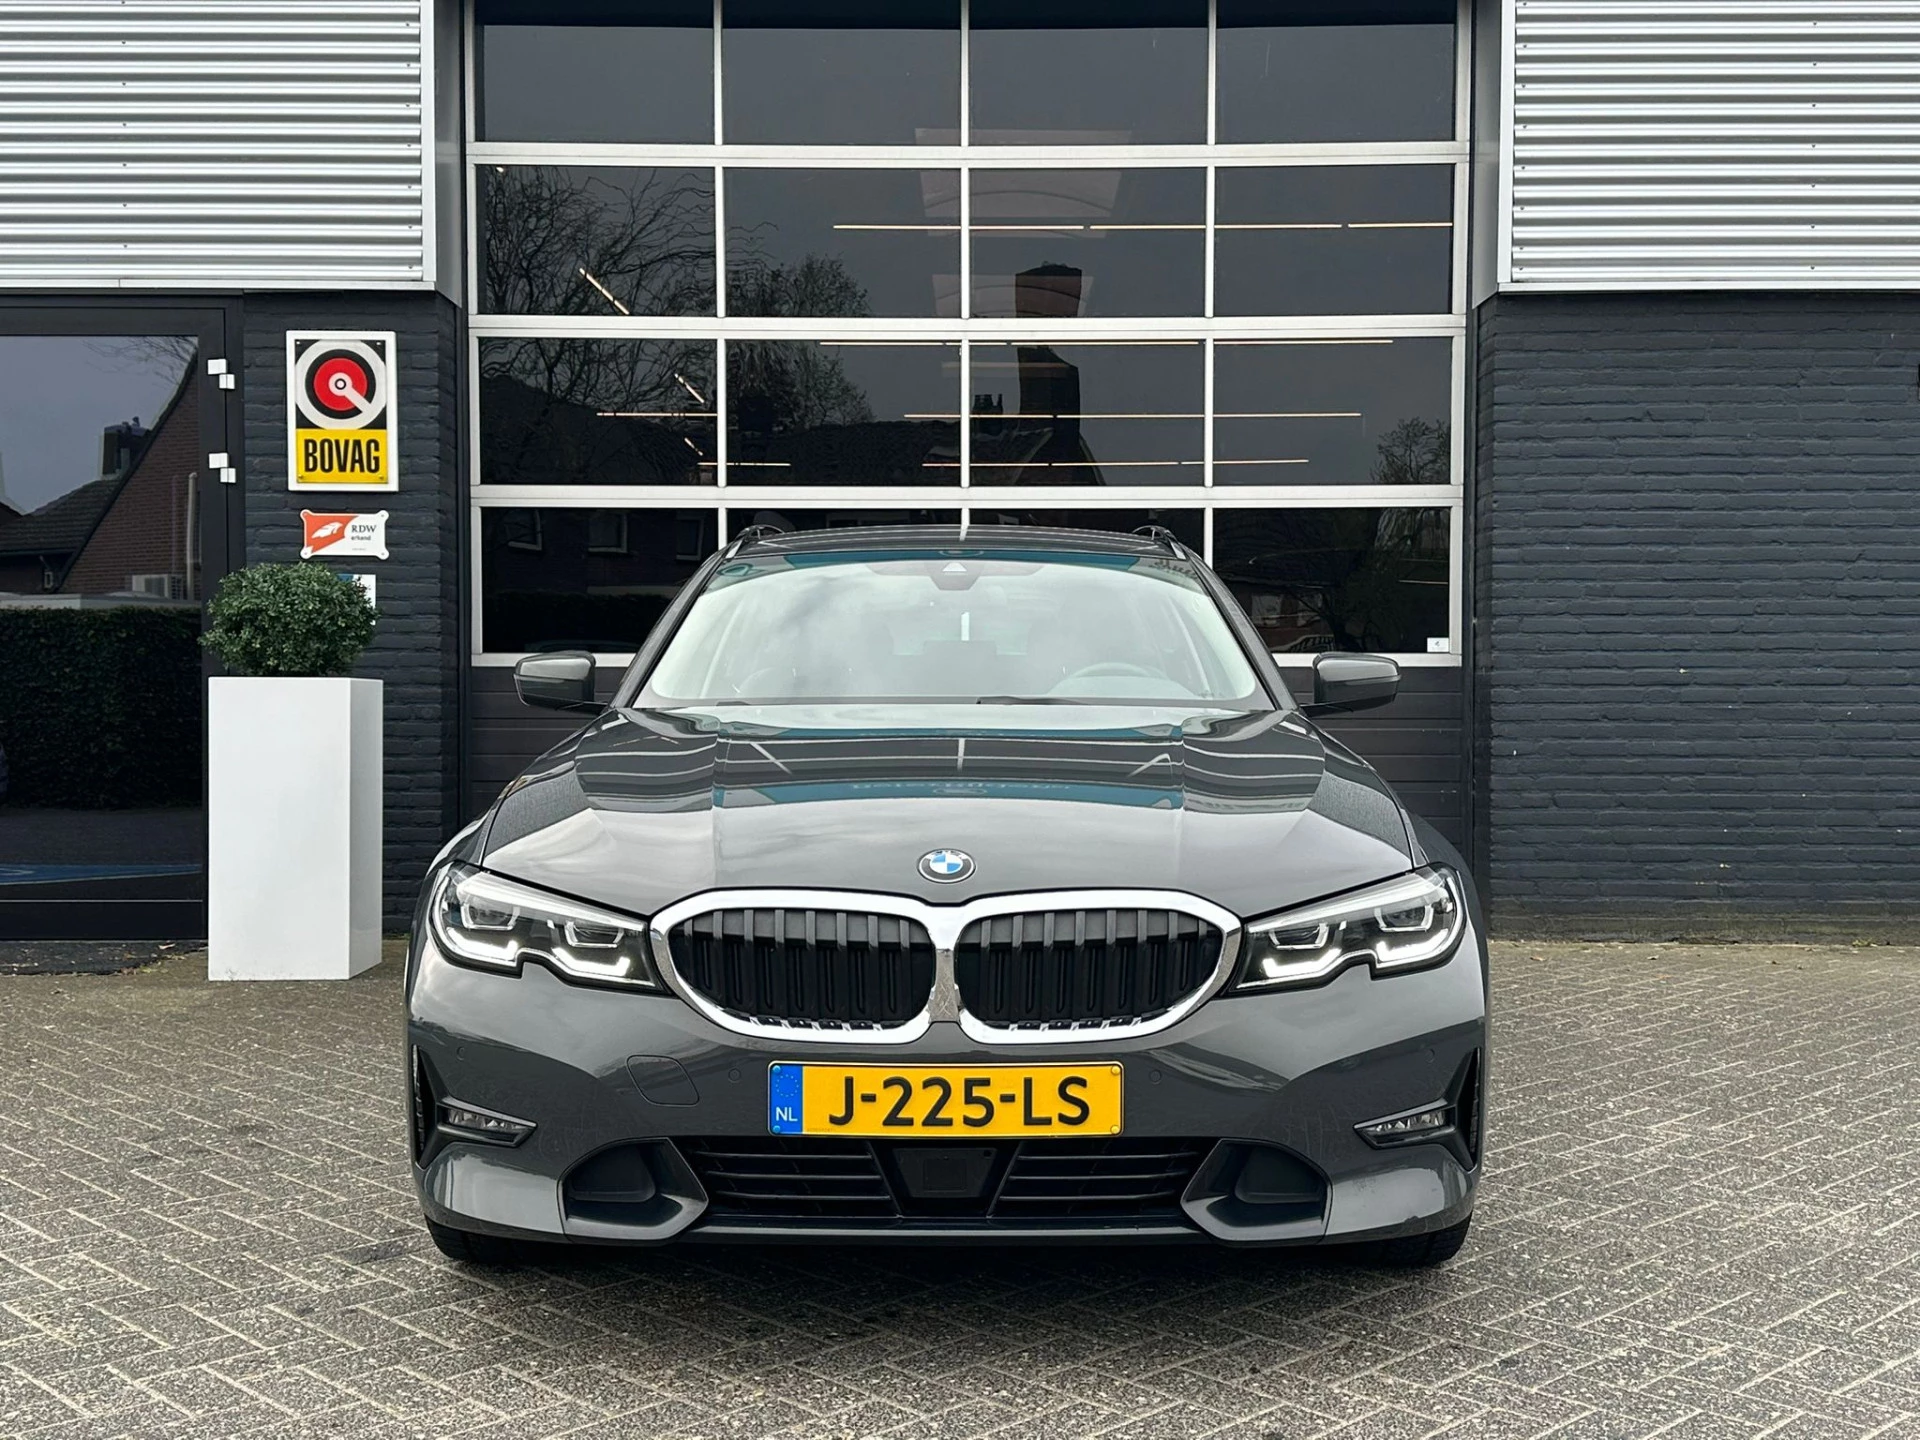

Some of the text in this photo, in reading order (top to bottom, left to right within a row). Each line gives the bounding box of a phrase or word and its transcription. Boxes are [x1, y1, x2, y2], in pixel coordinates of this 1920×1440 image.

[303, 438, 380, 473] BOVAG
[351, 524, 377, 533] RDW
[775, 1106, 798, 1122] NL
[828, 1076, 1090, 1127] J-225-LS
